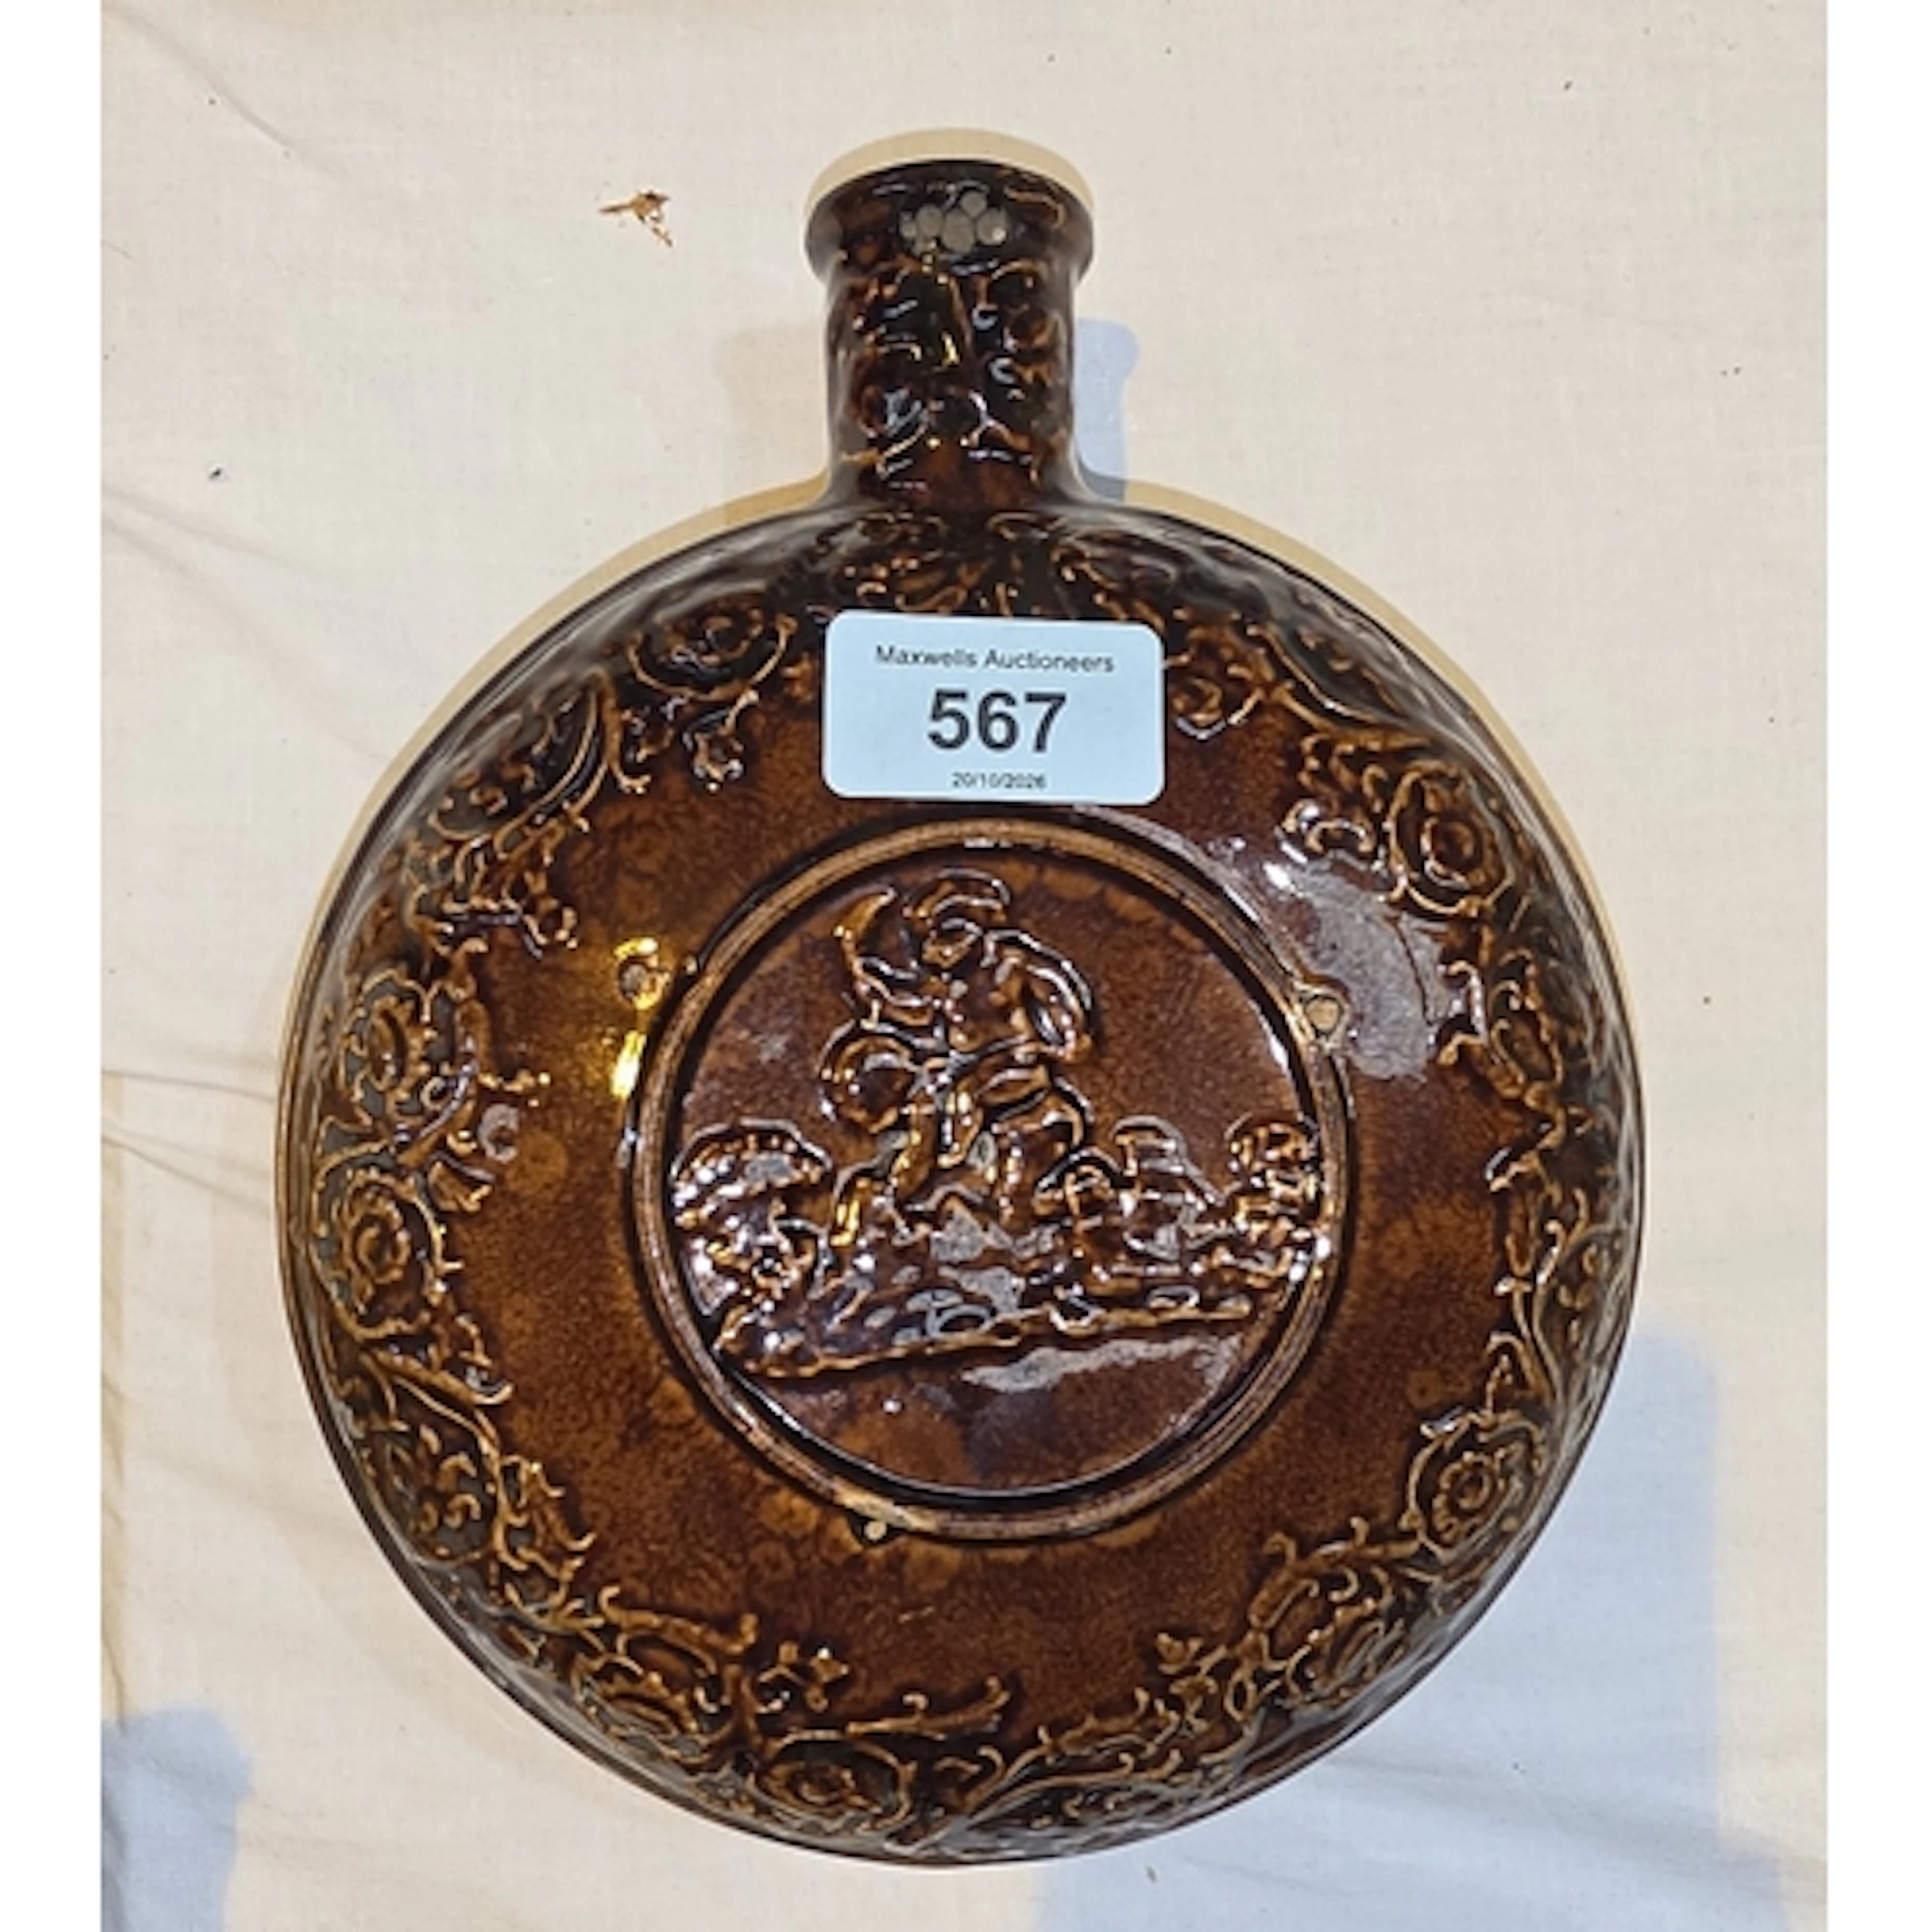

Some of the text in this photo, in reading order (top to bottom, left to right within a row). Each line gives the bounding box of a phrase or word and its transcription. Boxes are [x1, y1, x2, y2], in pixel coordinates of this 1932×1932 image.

[876, 645, 1114, 672] Maxwells Auctioneers
[927, 689, 1067, 753] 567
